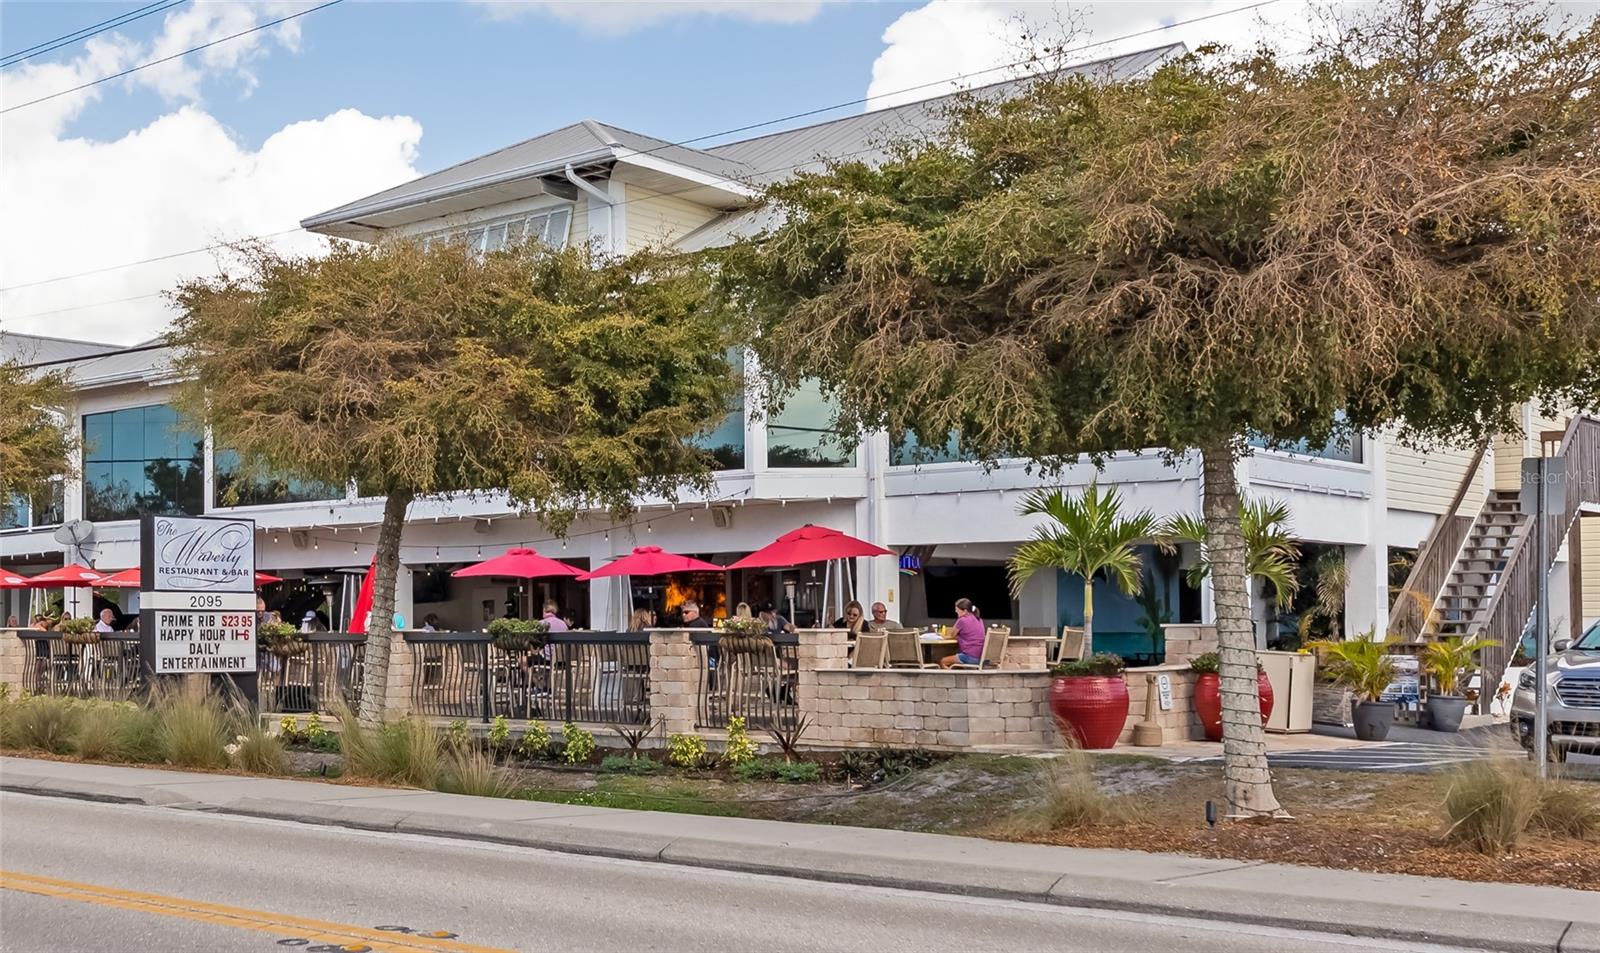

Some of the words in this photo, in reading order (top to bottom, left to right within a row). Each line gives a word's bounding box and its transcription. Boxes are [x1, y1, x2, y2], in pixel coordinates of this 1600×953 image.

[157, 520, 177, 536] The
[161, 523, 251, 568] Waverly
[159, 567, 218, 576] RESTAURANT
[190, 595, 222, 608] 2095
[161, 615, 193, 627] PRIME
[198, 615, 215, 627] RIB
[160, 629, 194, 641] HAPPY
[200, 629, 225, 641] HOUR
[189, 643, 220, 655] DAILY
[162, 657, 246, 669] ENTERTAINMENT
